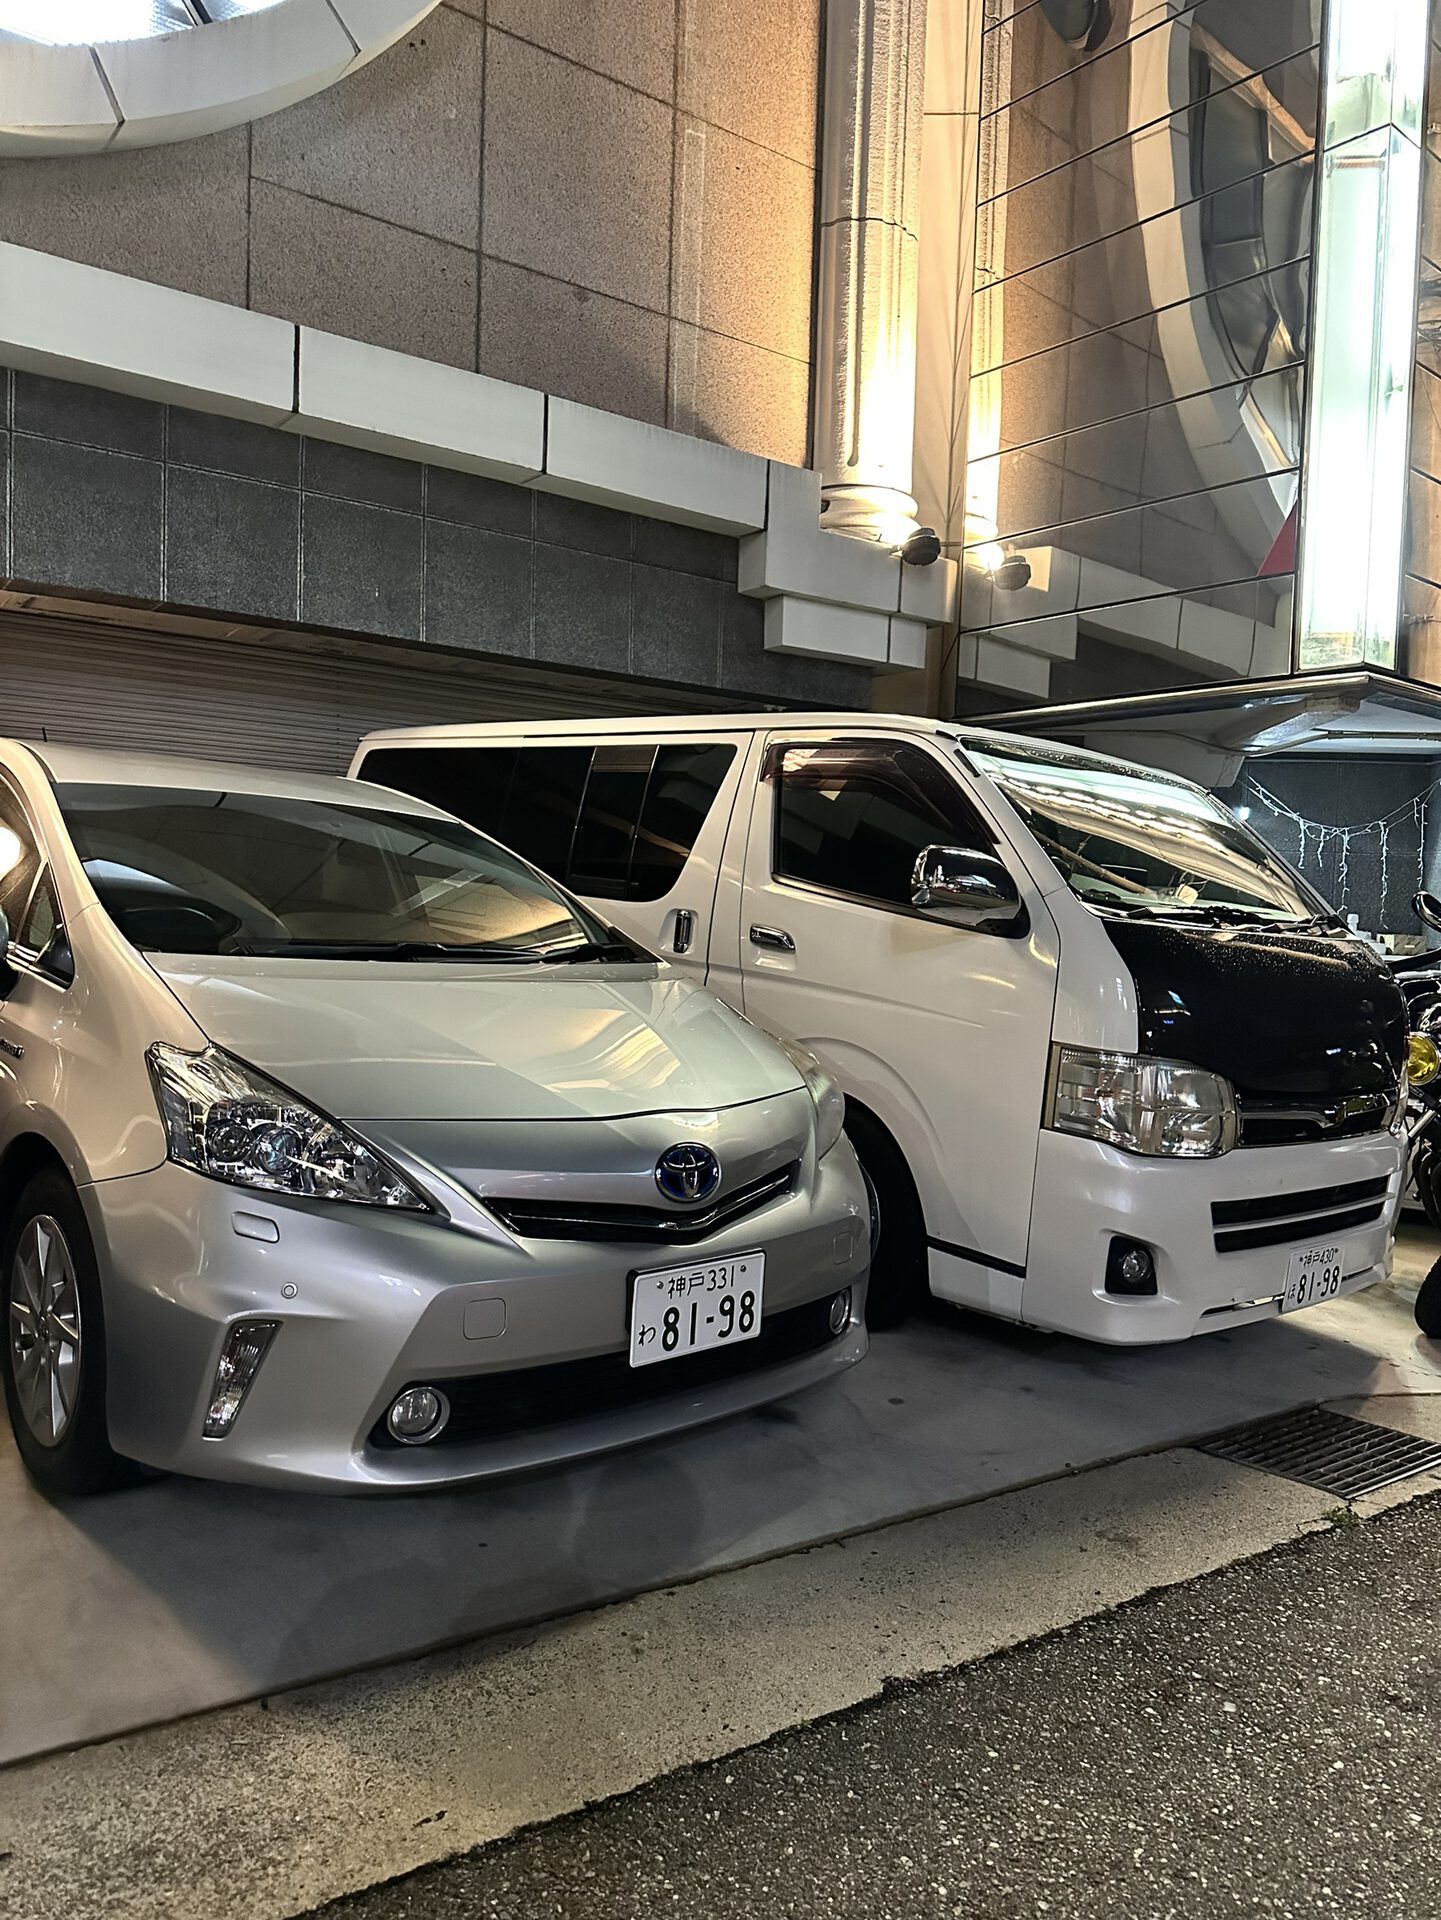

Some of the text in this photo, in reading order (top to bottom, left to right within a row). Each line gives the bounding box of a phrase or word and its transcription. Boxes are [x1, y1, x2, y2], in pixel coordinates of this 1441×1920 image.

[667, 1265, 735, 1299] 神戸331
[1297, 1265, 1340, 1304] 81-98
[638, 1290, 755, 1352] わ 81-98
